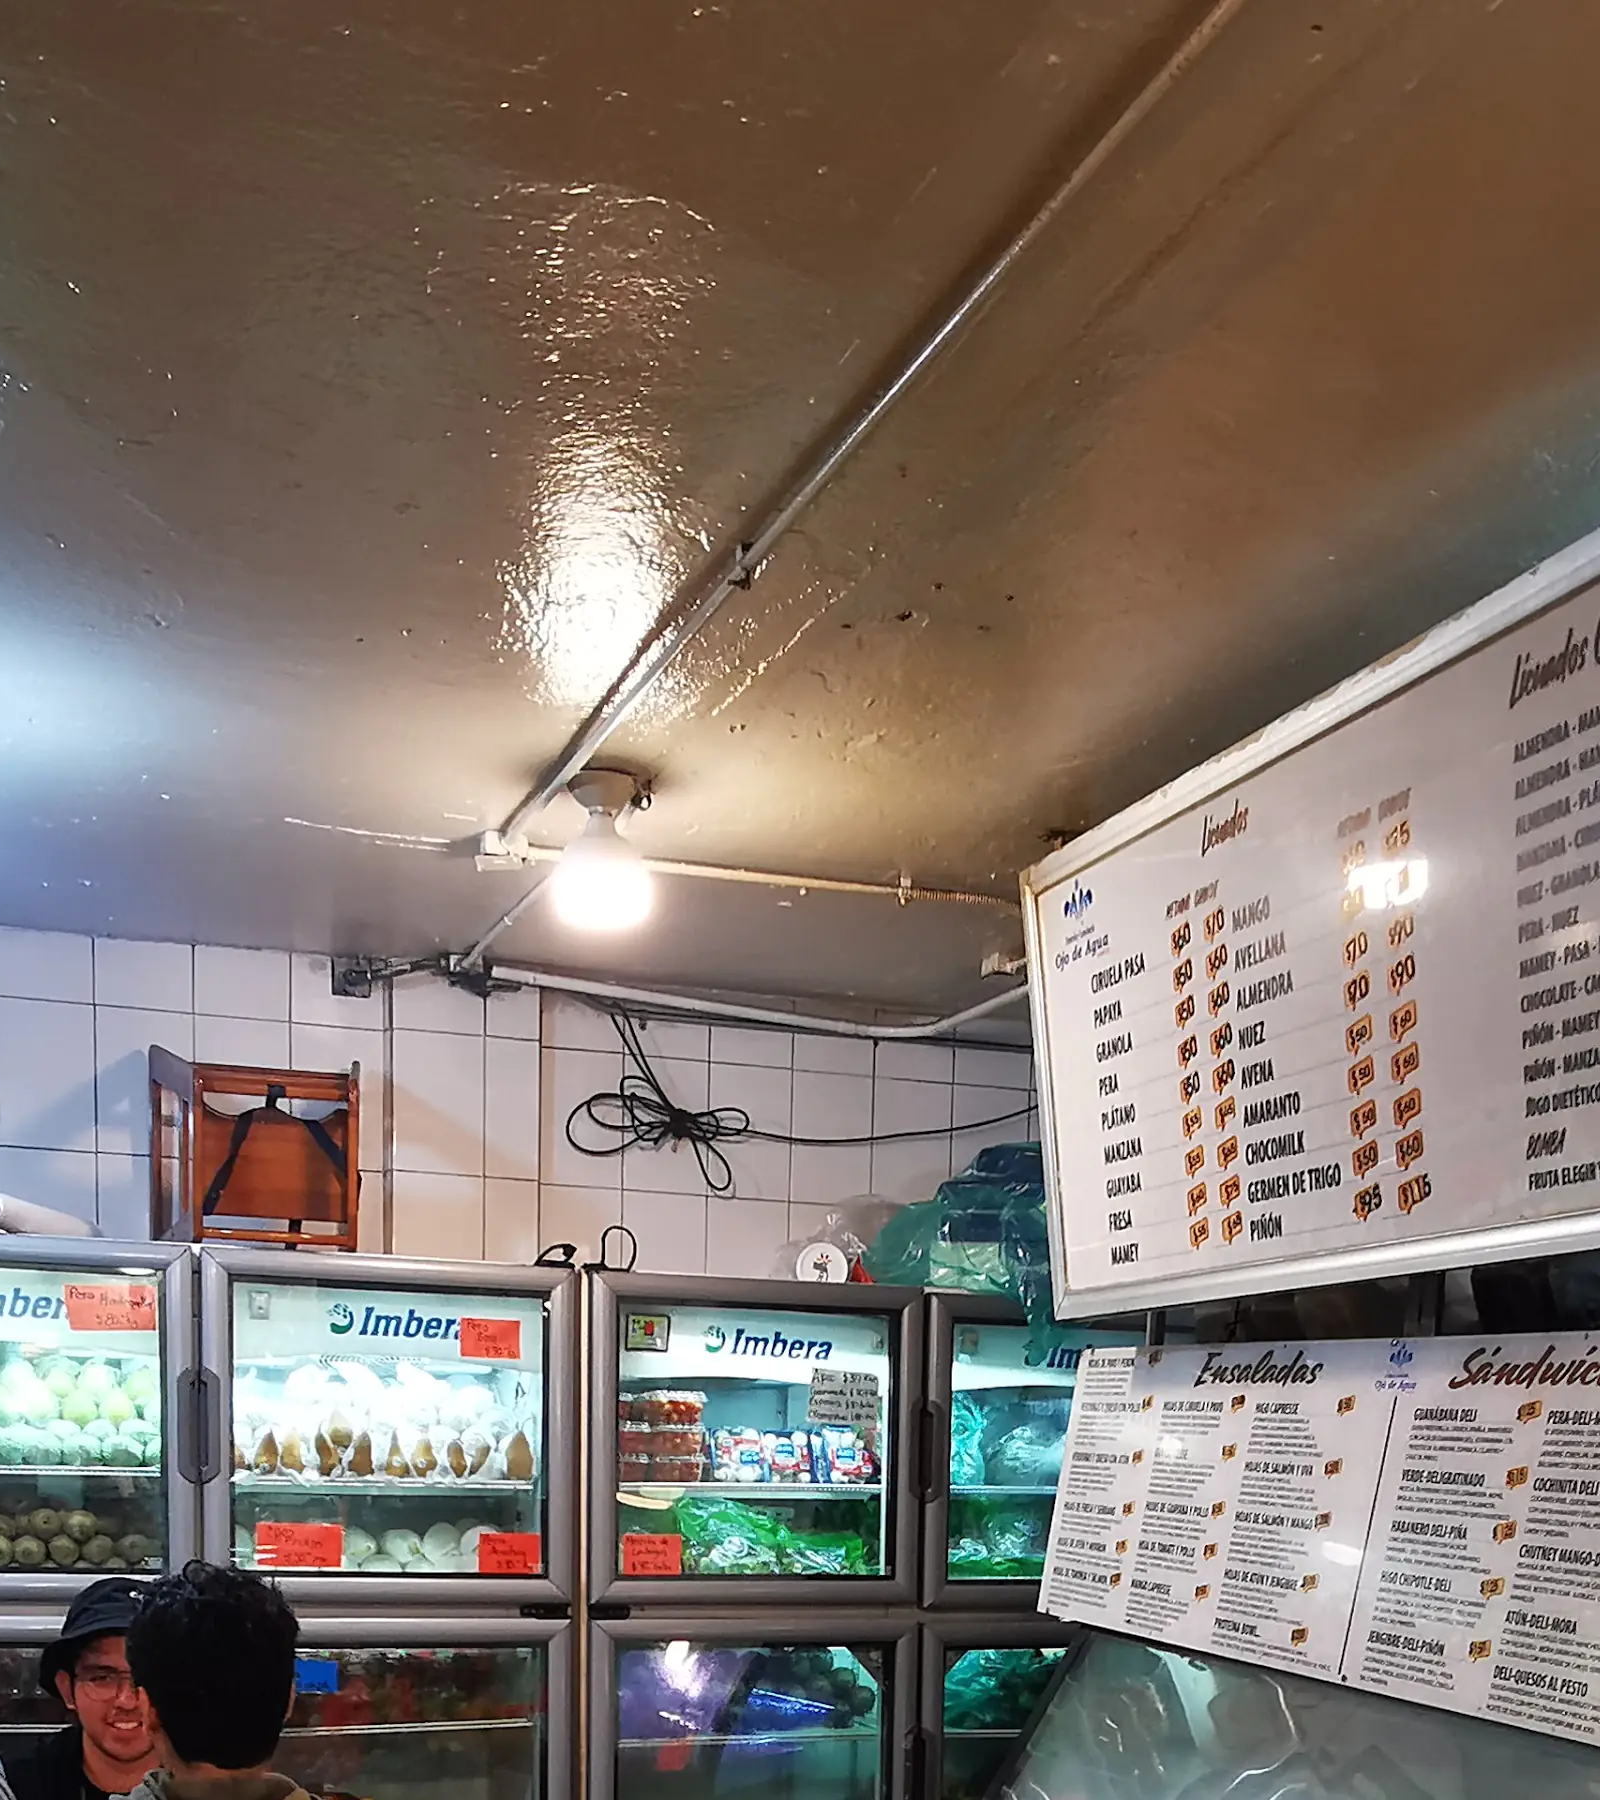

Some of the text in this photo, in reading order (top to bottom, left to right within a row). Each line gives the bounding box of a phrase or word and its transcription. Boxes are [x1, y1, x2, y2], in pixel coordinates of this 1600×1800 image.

[1234, 930, 1286, 973] AVELLANA
[1236, 969, 1294, 1012] ALMENDRA
[1521, 981, 1577, 1013] CHOCOLATE
[1238, 1020, 1266, 1050] NUEZ
[1241, 1058, 1274, 1089] AVENA
[1244, 1091, 1300, 1128] AMARANTO
[1245, 1130, 1305, 1166] CHOCOMILK
[1248, 1163, 1341, 1204] GERMEN DE TRIGO
[1529, 1167, 1559, 1191] FRUTA
[1250, 1212, 1282, 1241] PIÑÓN
[358, 1307, 462, 1341] Imber
[730, 1328, 833, 1361] Imbera
[1193, 1350, 1324, 1388] Ensaladas
